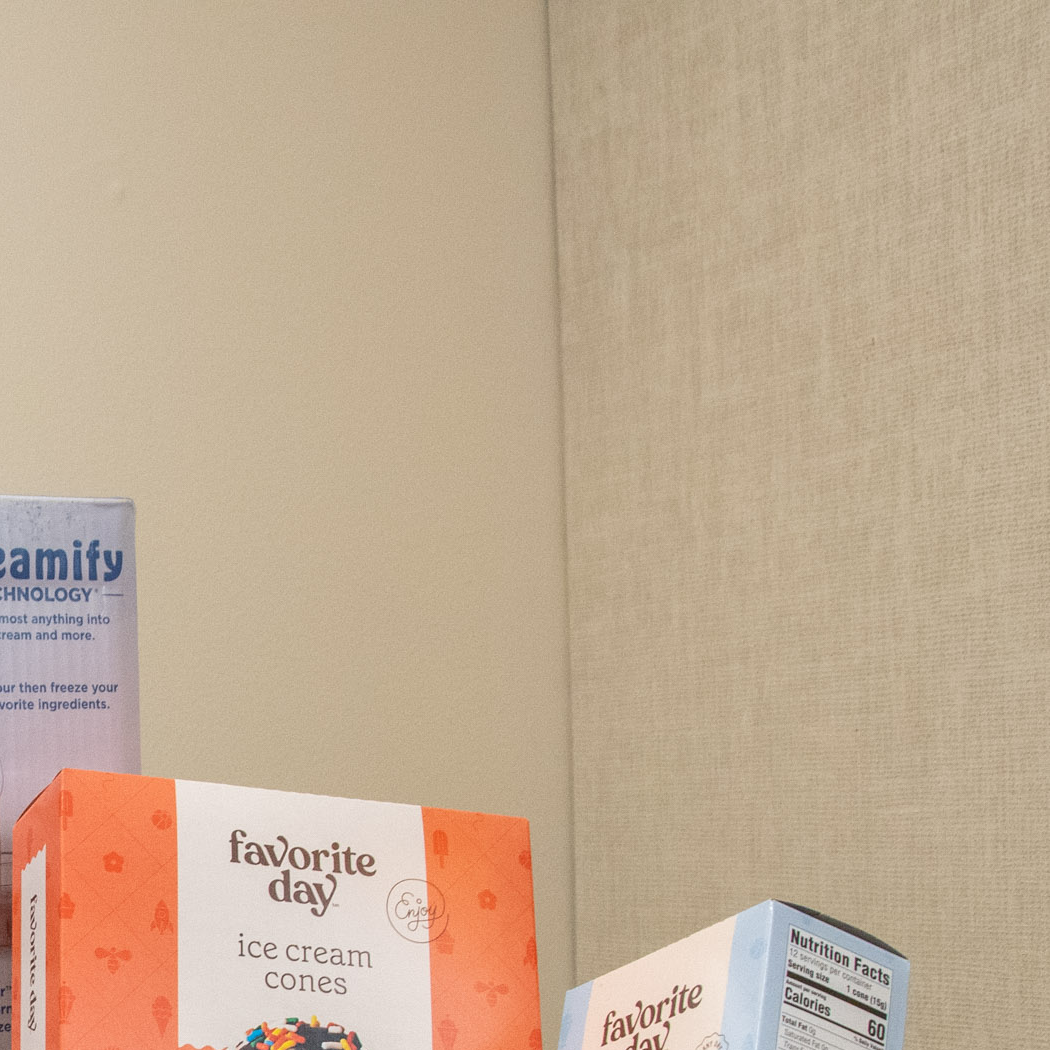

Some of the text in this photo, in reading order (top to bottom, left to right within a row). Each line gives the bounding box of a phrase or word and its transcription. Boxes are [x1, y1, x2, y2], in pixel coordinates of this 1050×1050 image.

[31, 612, 84, 627] anything
[86, 614, 110, 625] into
[35, 629, 58, 641] and
[60, 631, 95, 641] more.
[18, 681, 47, 693] then
[49, 681, 88, 694] freeze
[90, 683, 119, 696] your
[37, 698, 110, 714] ingredients.
[229, 829, 377, 877] favorite
[268, 869, 338, 917] day
[395, 891, 445, 932] Enjoy
[28, 894, 38, 1032] favorite day
[238, 933, 373, 969] ice cream
[789, 947, 872, 991] 12 servings per container
[790, 928, 890, 986] Nutrition Facts
[264, 970, 348, 995] cones
[787, 958, 814, 978] Serving
[815, 970, 829, 983] size
[852, 988, 868, 1000] cone
[869, 995, 887, 1010] (15g)
[601, 984, 703, 1047] favorite
[781, 1014, 796, 1027] Total
[797, 1021, 807, 1031] Fat
[784, 985, 885, 1041] Calories 60
